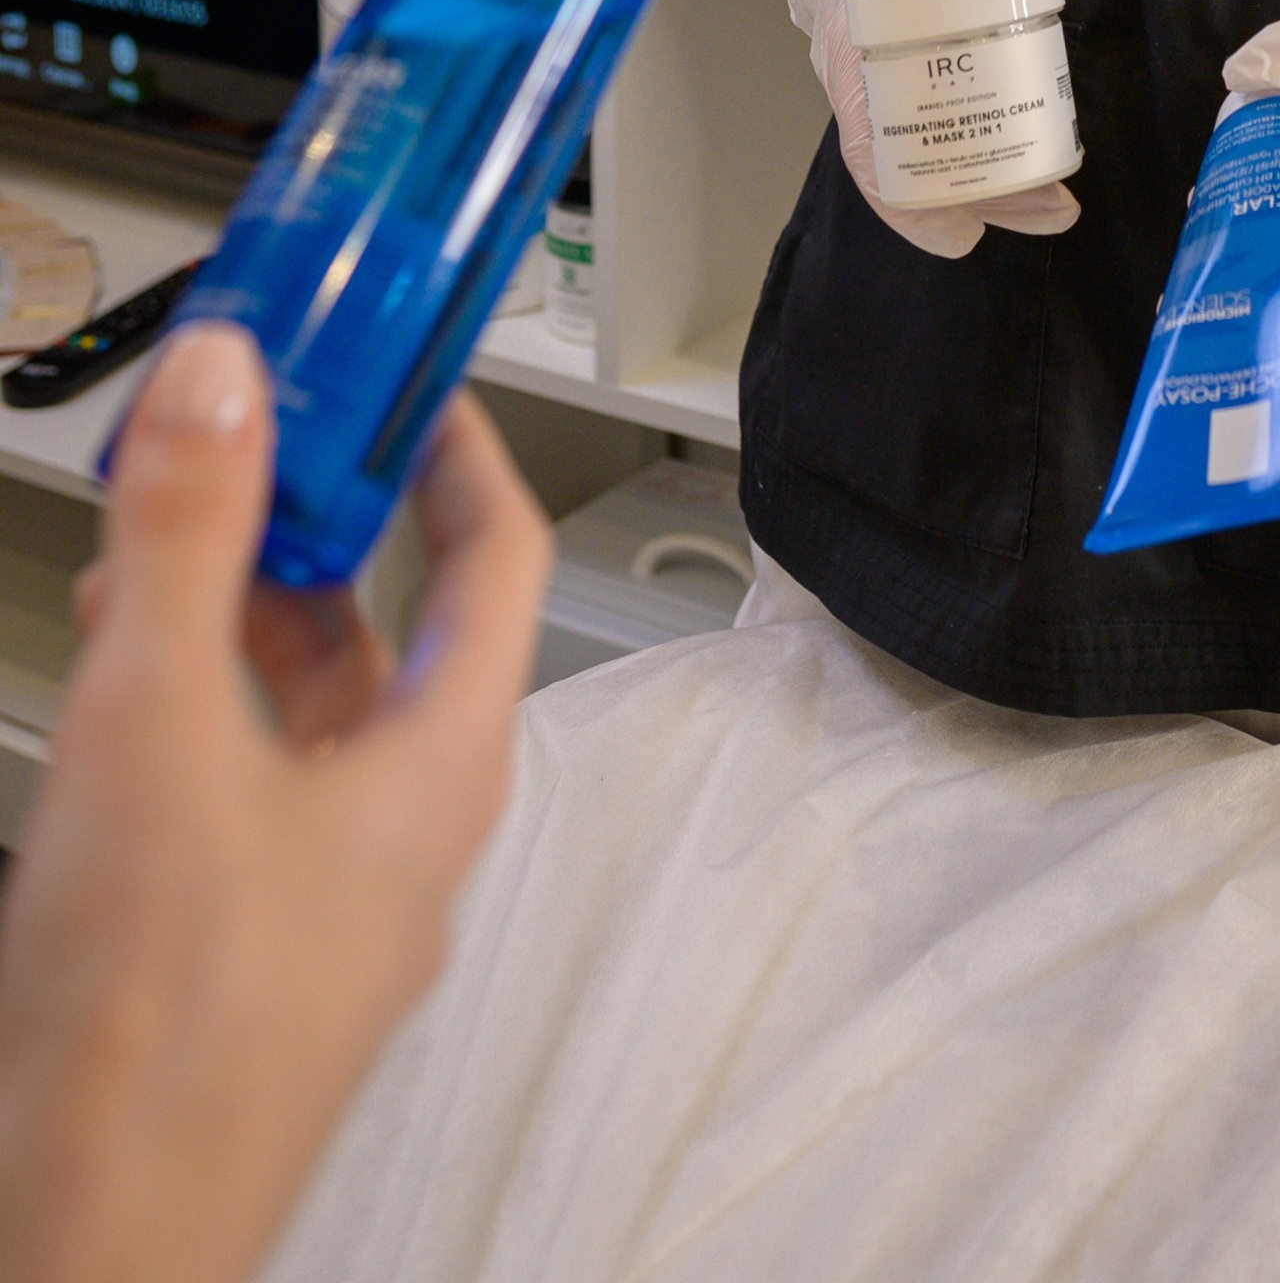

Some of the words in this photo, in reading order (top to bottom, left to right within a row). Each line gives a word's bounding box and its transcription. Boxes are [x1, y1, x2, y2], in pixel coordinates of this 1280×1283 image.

[927, 53, 974, 78] IRC
[967, 92, 997, 104] EDITION
[883, 118, 955, 137] REGENERATING
[959, 108, 1006, 127] RETINOL
[1009, 97, 1045, 116] CREAM
[933, 130, 966, 145] MASK
[969, 129, 976, 139] 2
[979, 125, 992, 137] IN
[996, 122, 1002, 133] 1
[1255, 171, 1273, 185] pH
